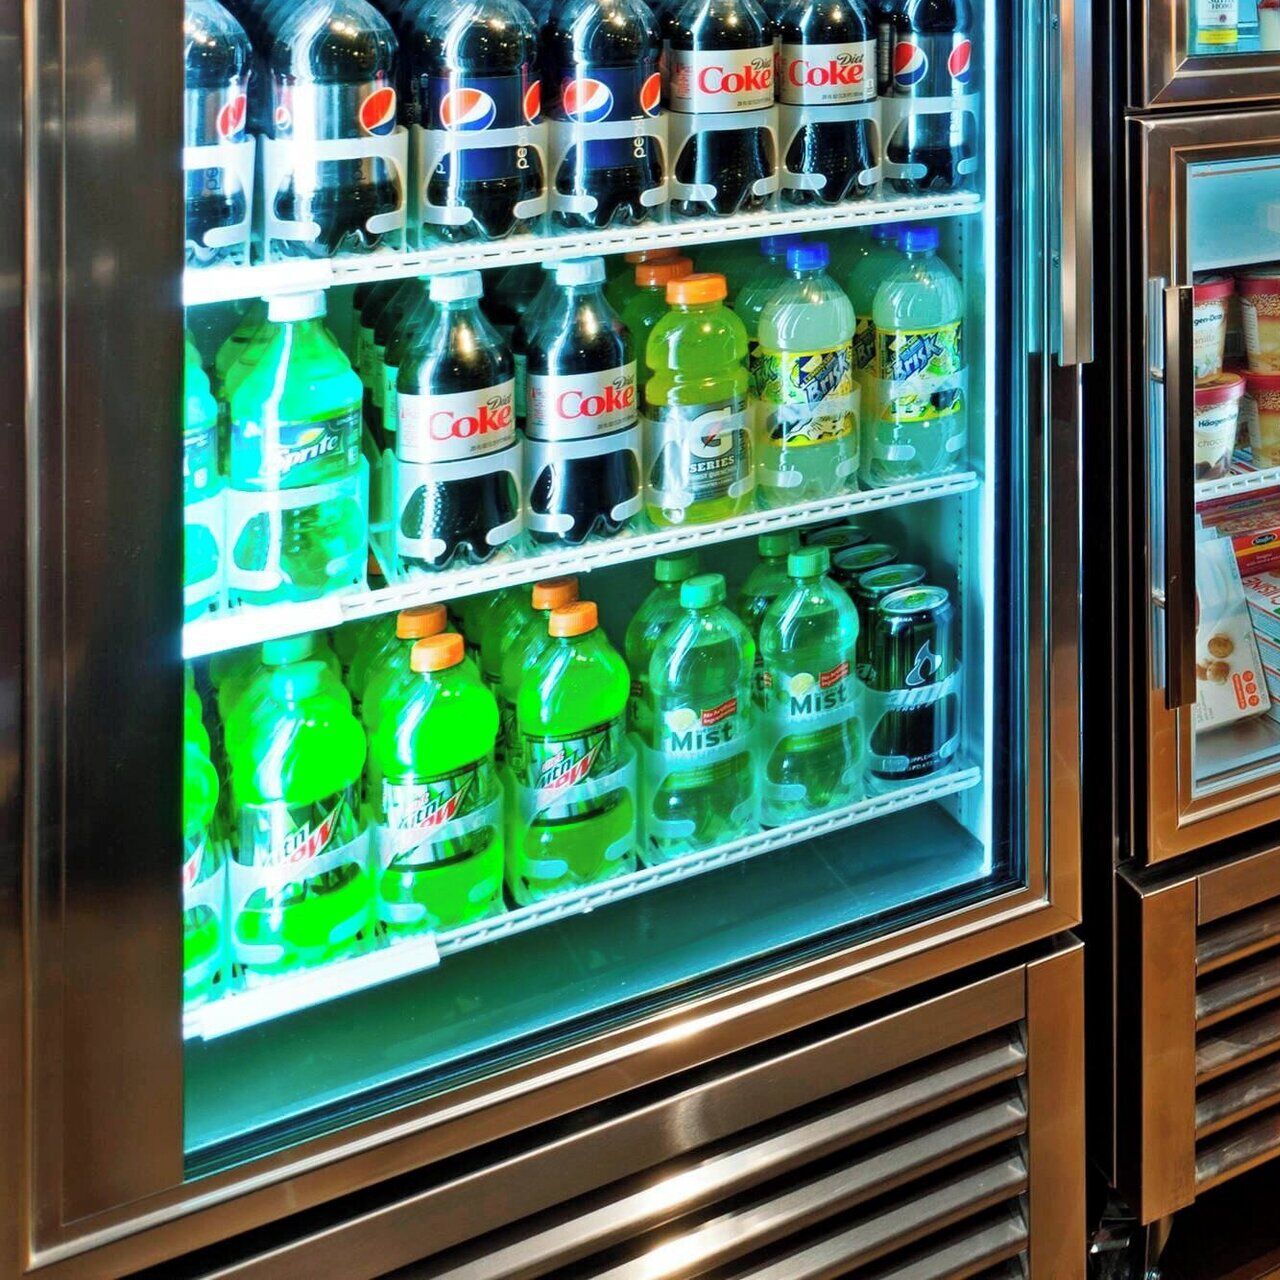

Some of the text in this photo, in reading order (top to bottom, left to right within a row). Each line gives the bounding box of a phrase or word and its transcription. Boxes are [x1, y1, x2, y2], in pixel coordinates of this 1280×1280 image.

[697, 65, 772, 95] Coke
[787, 58, 864, 87] Coke
[556, 385, 636, 420] Coke
[429, 404, 513, 442] Coke
[688, 455, 735, 474] SERIES
[790, 685, 847, 716] Mist
[671, 722, 733, 752] Mist
